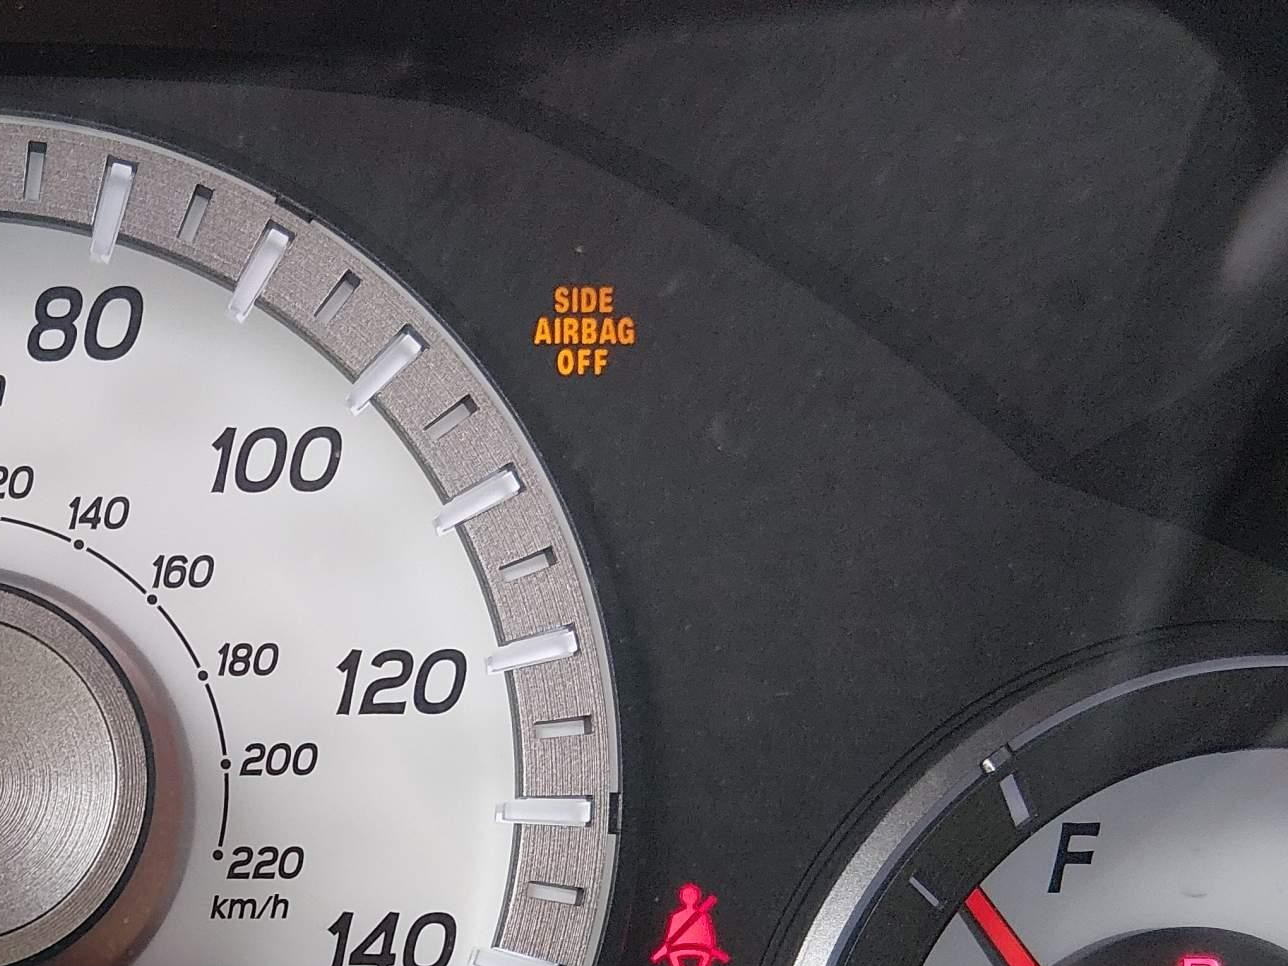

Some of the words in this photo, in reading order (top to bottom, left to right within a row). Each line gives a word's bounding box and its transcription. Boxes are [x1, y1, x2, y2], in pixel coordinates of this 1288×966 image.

[555, 287, 613, 313] SIDE
[27, 286, 143, 361] 80
[535, 318, 634, 344] AIRBAG
[558, 349, 607, 375] OFF
[211, 427, 342, 493] 100
[69, 497, 129, 529] 140
[152, 555, 214, 588] 160
[218, 643, 278, 676] 180
[336, 649, 467, 715] 120
[240, 743, 318, 776] 200
[227, 847, 304, 879] 220
[1048, 823, 1100, 893] F
[211, 894, 288, 919] km/h
